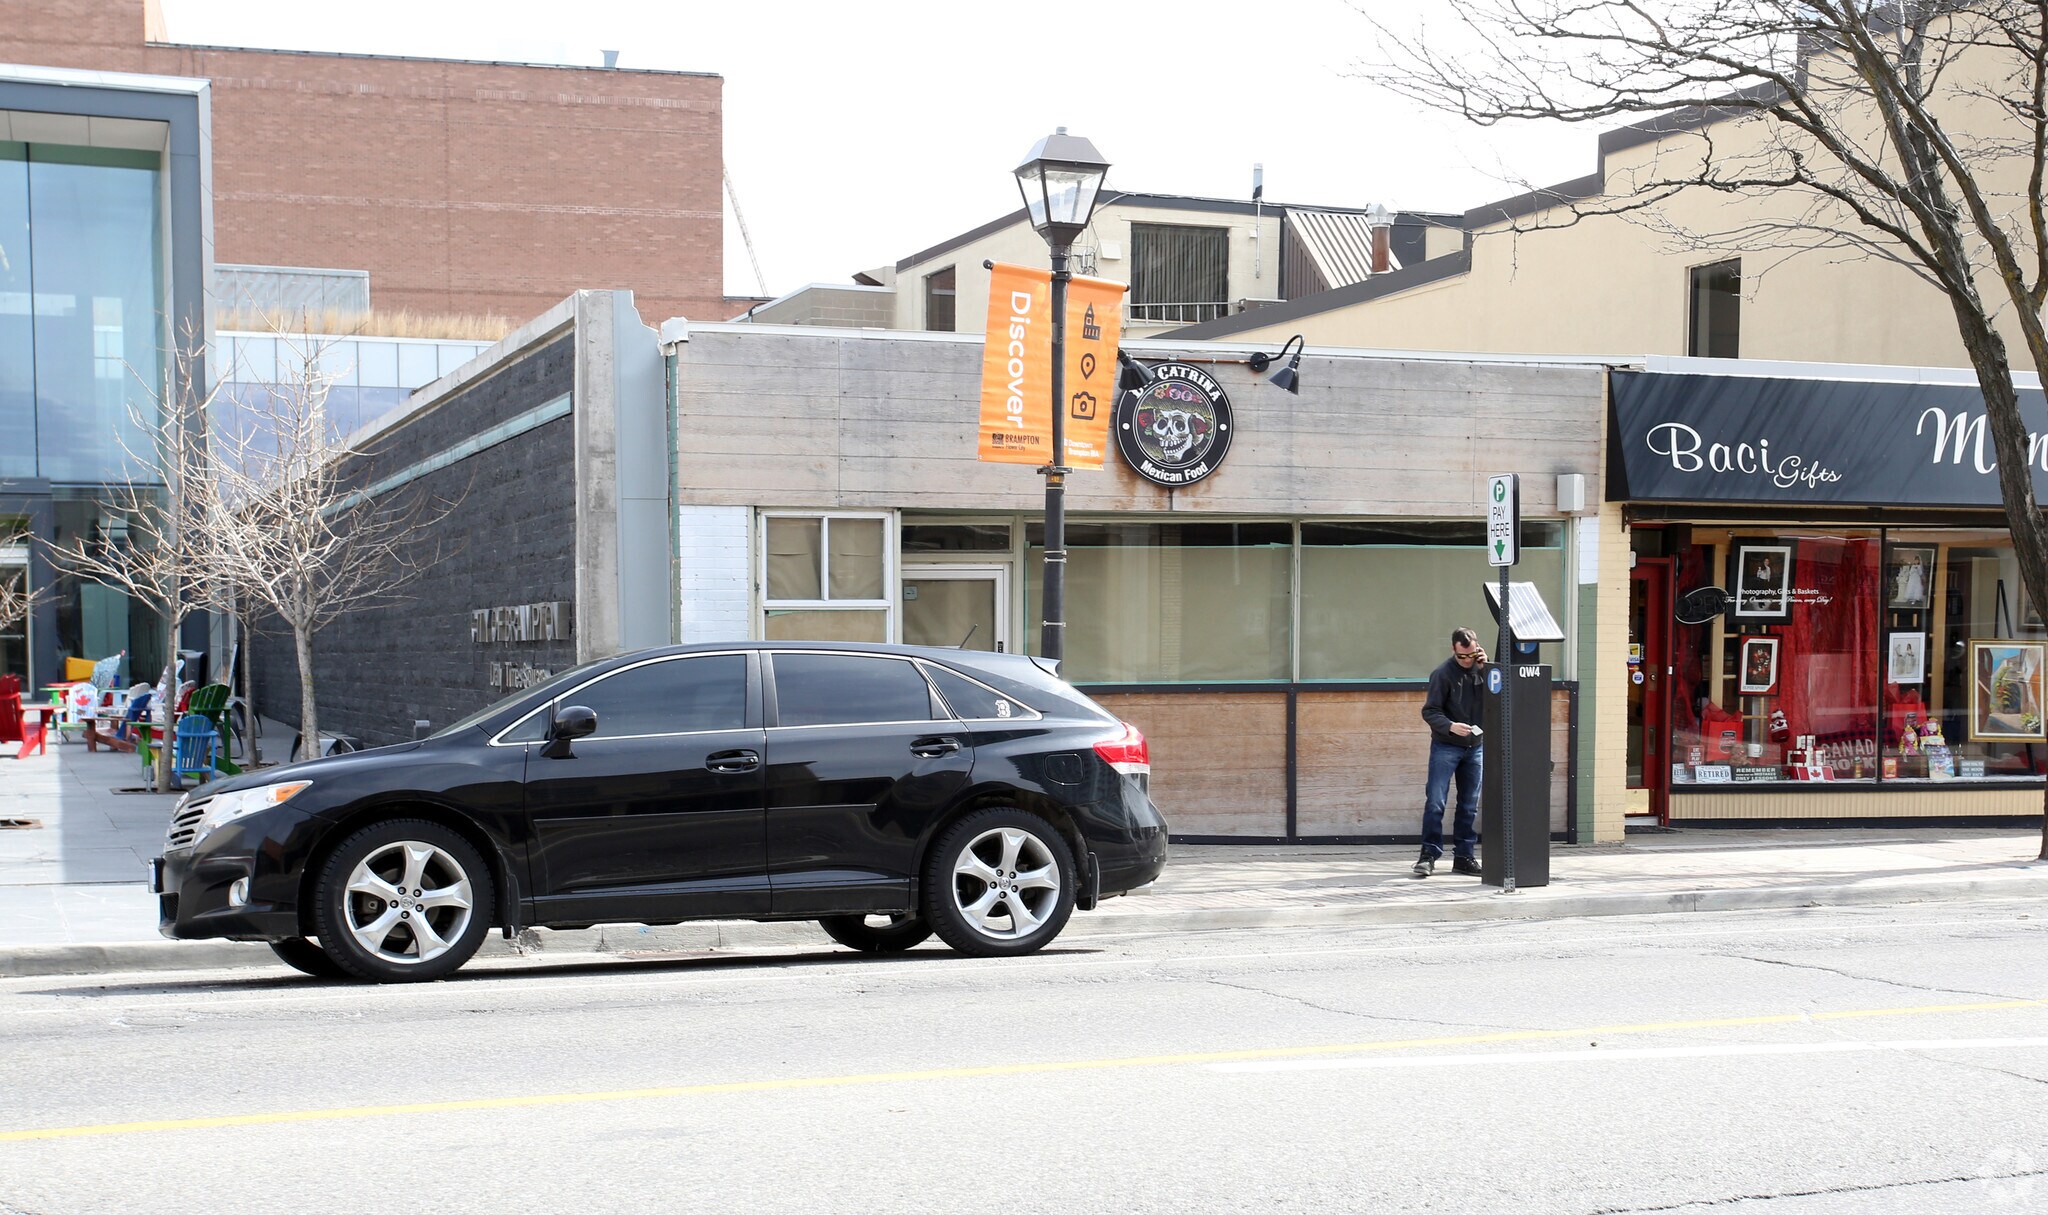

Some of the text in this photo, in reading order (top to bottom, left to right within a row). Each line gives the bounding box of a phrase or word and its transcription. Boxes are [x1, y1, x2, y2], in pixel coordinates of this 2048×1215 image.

[1006, 290, 1031, 429] Discover
[1157, 366, 1222, 402] CATRINA
[1005, 434, 1040, 446] BRAMPTON
[1646, 422, 1842, 489] Baci Gifts
[1140, 460, 1209, 482] Mexican Food
[1492, 506, 1506, 521] PAY
[1490, 522, 1510, 538] HERE
[1519, 666, 1541, 678] QW4
[1821, 738, 1876, 759] CANAD
[1698, 770, 1730, 778] RETIRED
